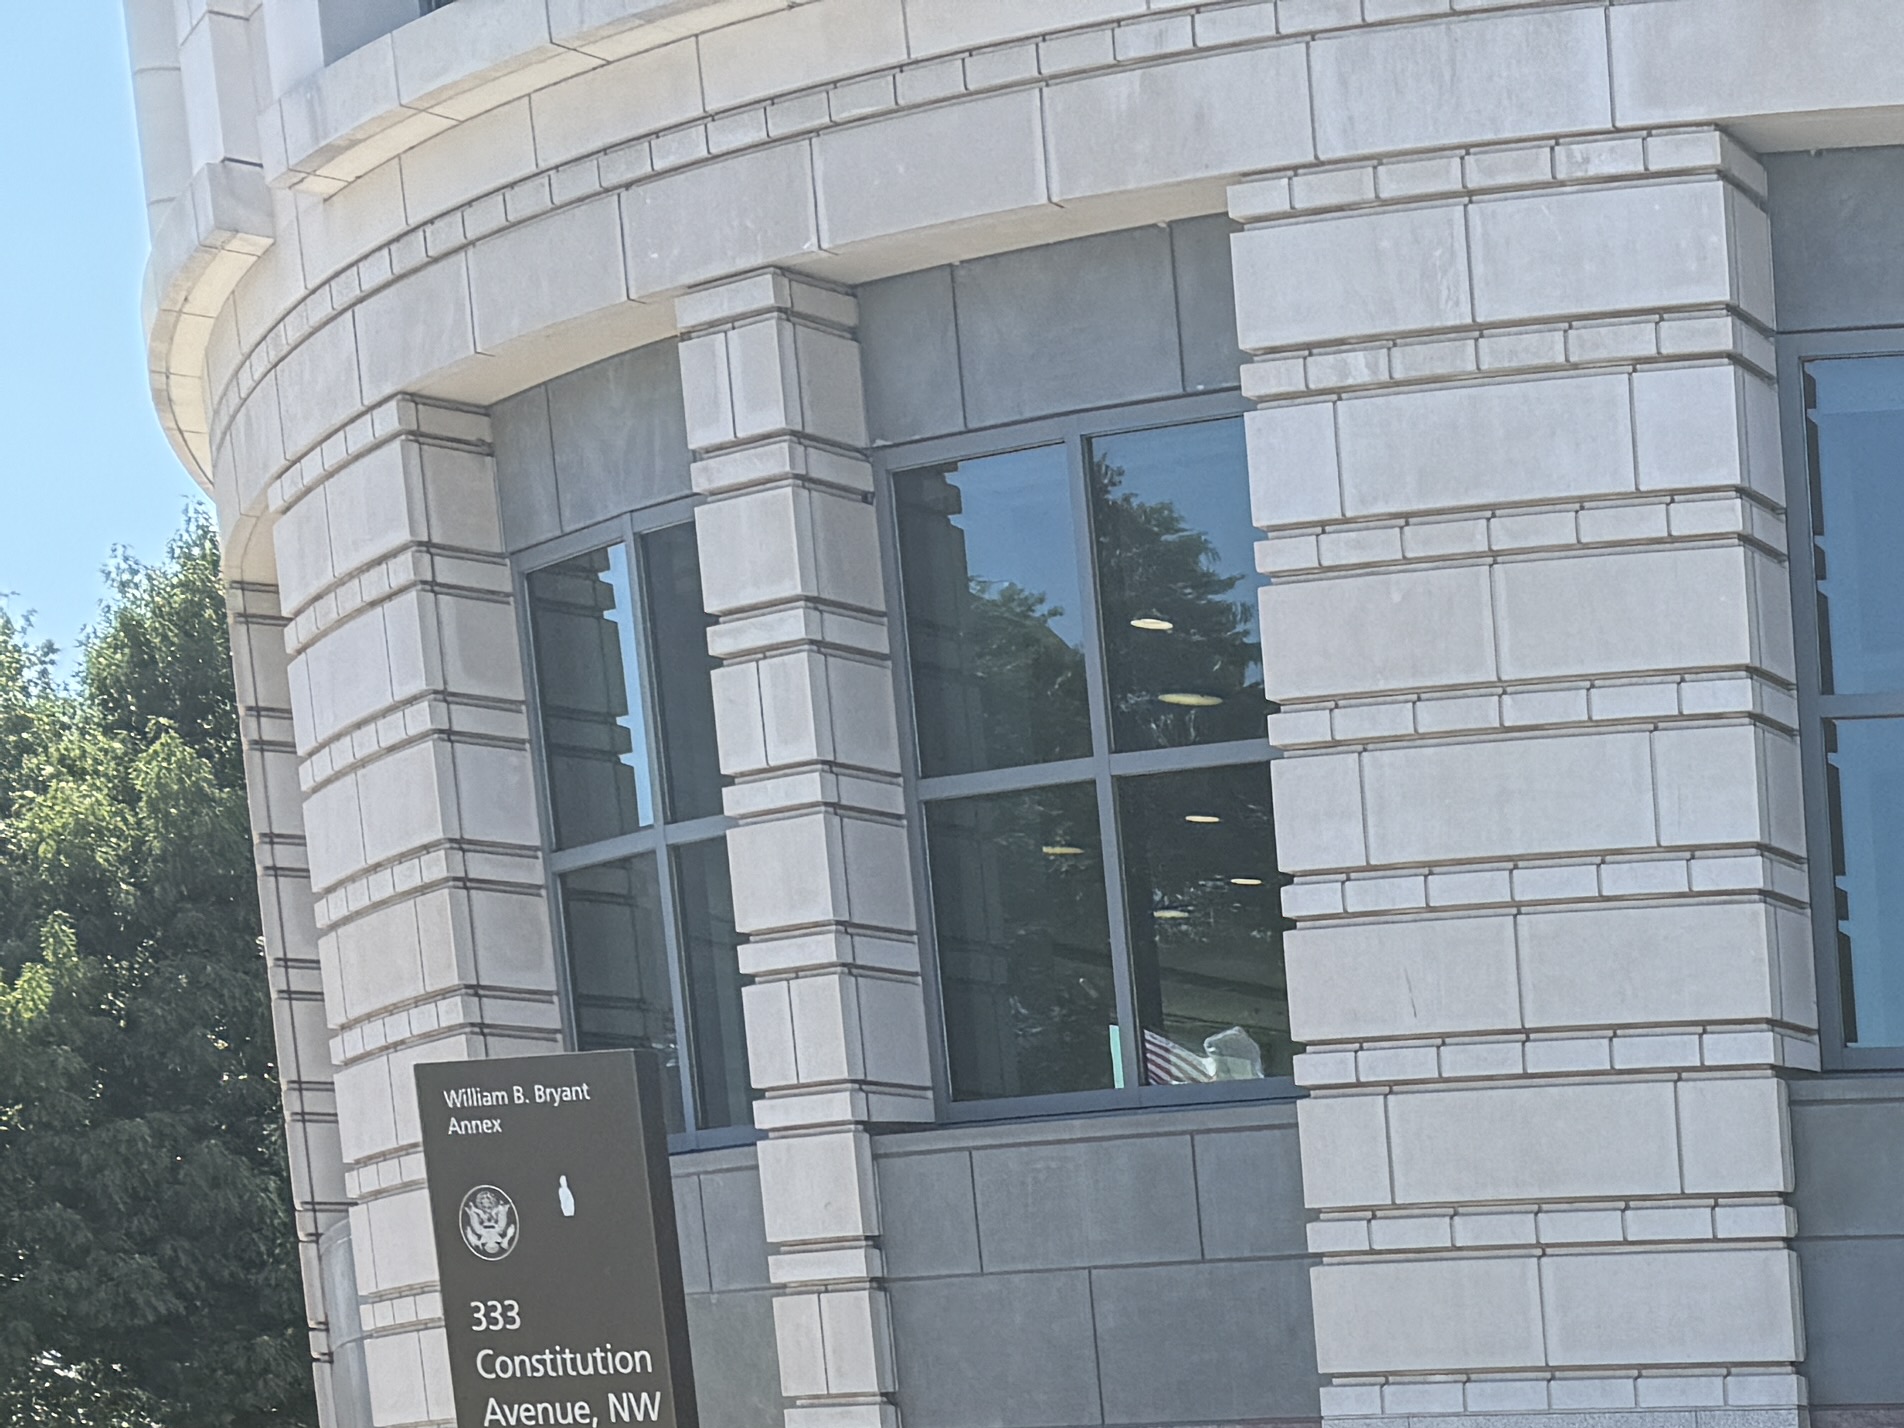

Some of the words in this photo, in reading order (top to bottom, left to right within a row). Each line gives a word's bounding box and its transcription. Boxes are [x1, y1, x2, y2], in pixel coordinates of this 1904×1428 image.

[444, 1088, 509, 1108] William
[513, 1086, 530, 1104] B.
[534, 1083, 590, 1107] Bryant
[448, 1117, 502, 1135] Annex
[470, 1300, 521, 1331] 333
[476, 1343, 653, 1379] Constitution
[484, 1397, 599, 1428] Avenue,
[607, 1391, 661, 1422] NW
